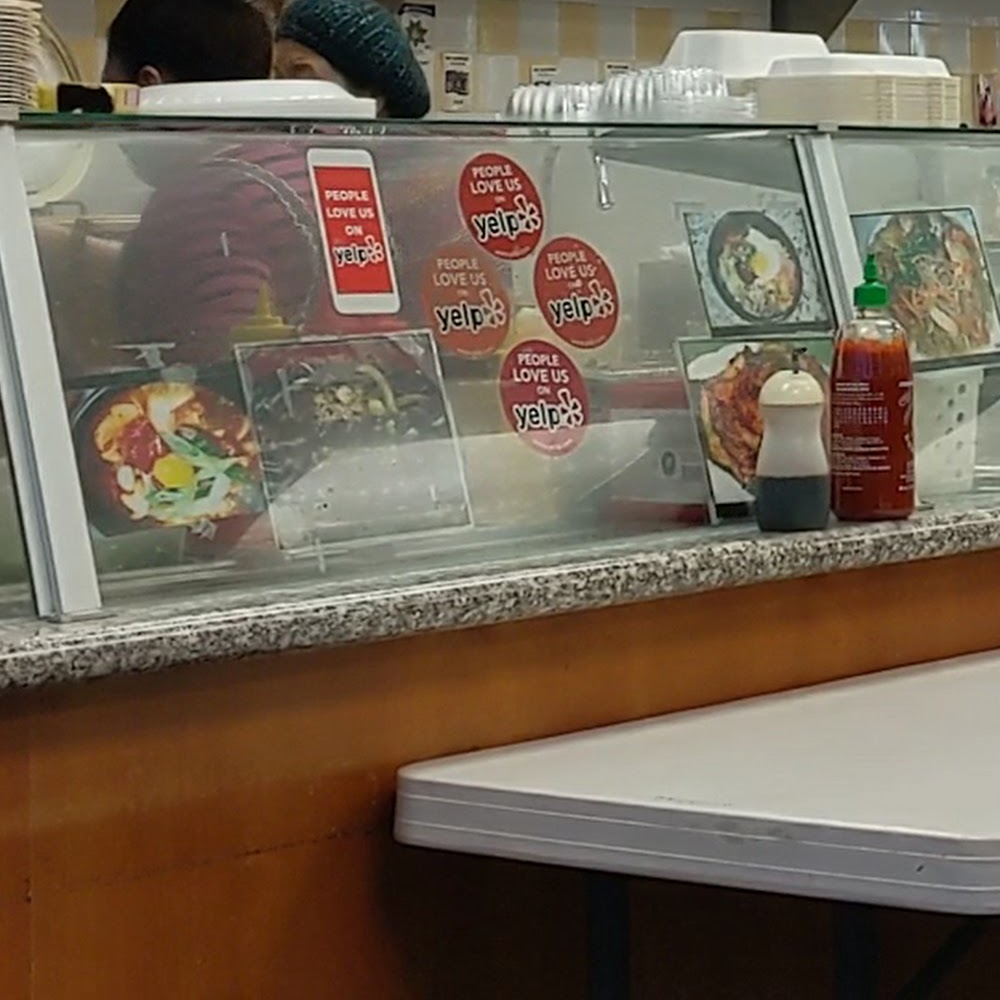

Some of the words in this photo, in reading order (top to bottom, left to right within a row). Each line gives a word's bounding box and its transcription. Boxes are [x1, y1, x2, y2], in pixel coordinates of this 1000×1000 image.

[471, 164, 513, 179] PEOPLE
[470, 179, 503, 195] LOVE
[506, 178, 522, 192] US
[325, 189, 369, 202] PEOPLE
[326, 207, 357, 219] LOVE
[358, 207, 375, 219] US
[345, 225, 363, 236] ON
[472, 208, 520, 240] yelp
[334, 244, 371, 267] yelp
[548, 251, 588, 265] PEOPLE
[437, 258, 478, 271] PEOPLE
[545, 265, 577, 280] LOVE
[578, 264, 597, 278] US
[433, 273, 466, 287] LOVE
[470, 273, 487, 286] US
[435, 302, 485, 333] yelp
[549, 294, 594, 326] yelp
[518, 353, 560, 367] PEOPLE
[513, 368, 549, 383] LOVE
[551, 368, 570, 384] US
[514, 402, 562, 432] yelp
